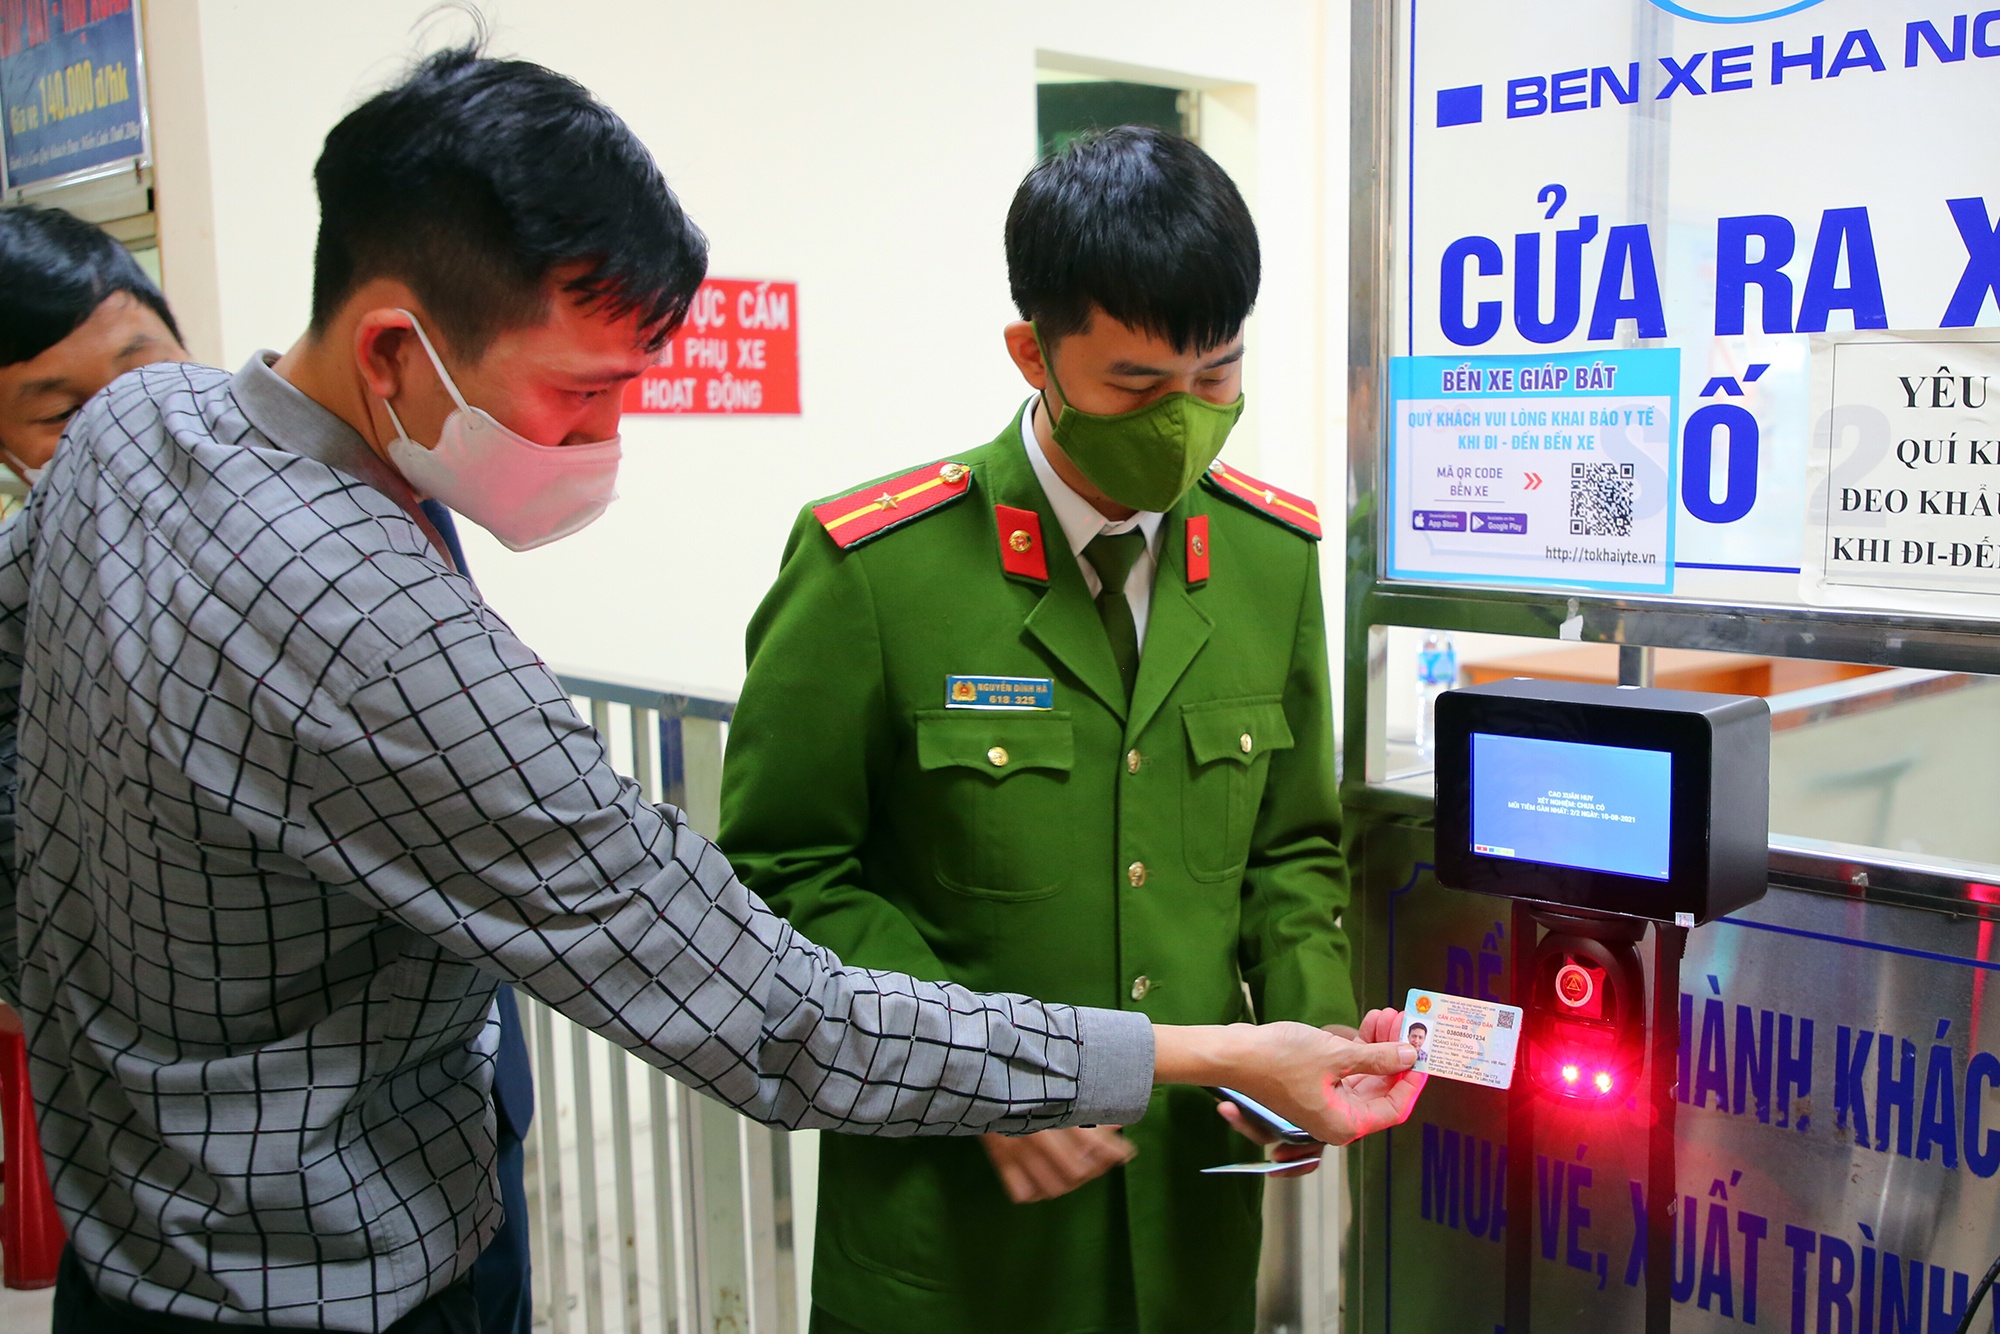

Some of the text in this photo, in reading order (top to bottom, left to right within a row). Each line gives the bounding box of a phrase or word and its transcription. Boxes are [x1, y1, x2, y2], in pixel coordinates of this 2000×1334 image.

[1506, 62, 1640, 119] BEN
[1655, 45, 1754, 101] XE
[1771, 29, 1886, 86] HA
[1439, 183, 1668, 347] CỬA
[1714, 206, 1889, 337] RA
[737, 280, 791, 331] CẤM
[684, 337, 729, 373] PHỤ
[737, 338, 767, 370] XE
[641, 371, 763, 413] HOẠT ĐỘNG
[1442, 362, 1617, 392] BẾN XE GIÁP BÁT
[1897, 366, 1992, 409] YÊU
[1437, 408, 1480, 427] KHÁCH
[1485, 411, 1506, 427] VUI
[1511, 408, 1547, 427] LÒNG
[1551, 411, 1585, 427] KHAI
[1589, 407, 1618, 427] BÁO
[1623, 411, 1632, 426] Y
[1637, 406, 1655, 427] TẾ
[1458, 435, 1480, 450] KHI
[1484, 435, 1498, 450] ĐI
[1511, 430, 1540, 450] ĐẾN
[1544, 430, 1573, 450] BẾN
[1577, 435, 1595, 450] XE
[1896, 432, 1959, 469] QUÍ
[1457, 467, 1472, 480] QR
[1475, 467, 1503, 479] CODE
[1475, 486, 1489, 497] XE
[1840, 483, 2000, 517] ĐEO KHẨ
[1428, 519, 1459, 529] App Store
[1487, 521, 1522, 532] Google Play
[1546, 546, 1656, 566] http://tokhaiyte.vn
[1832, 536, 2000, 569] KHI ĐI-ĐẾ
[1548, 790, 1561, 798] CAO
[1536, 1143, 1608, 1291] VÉ,
